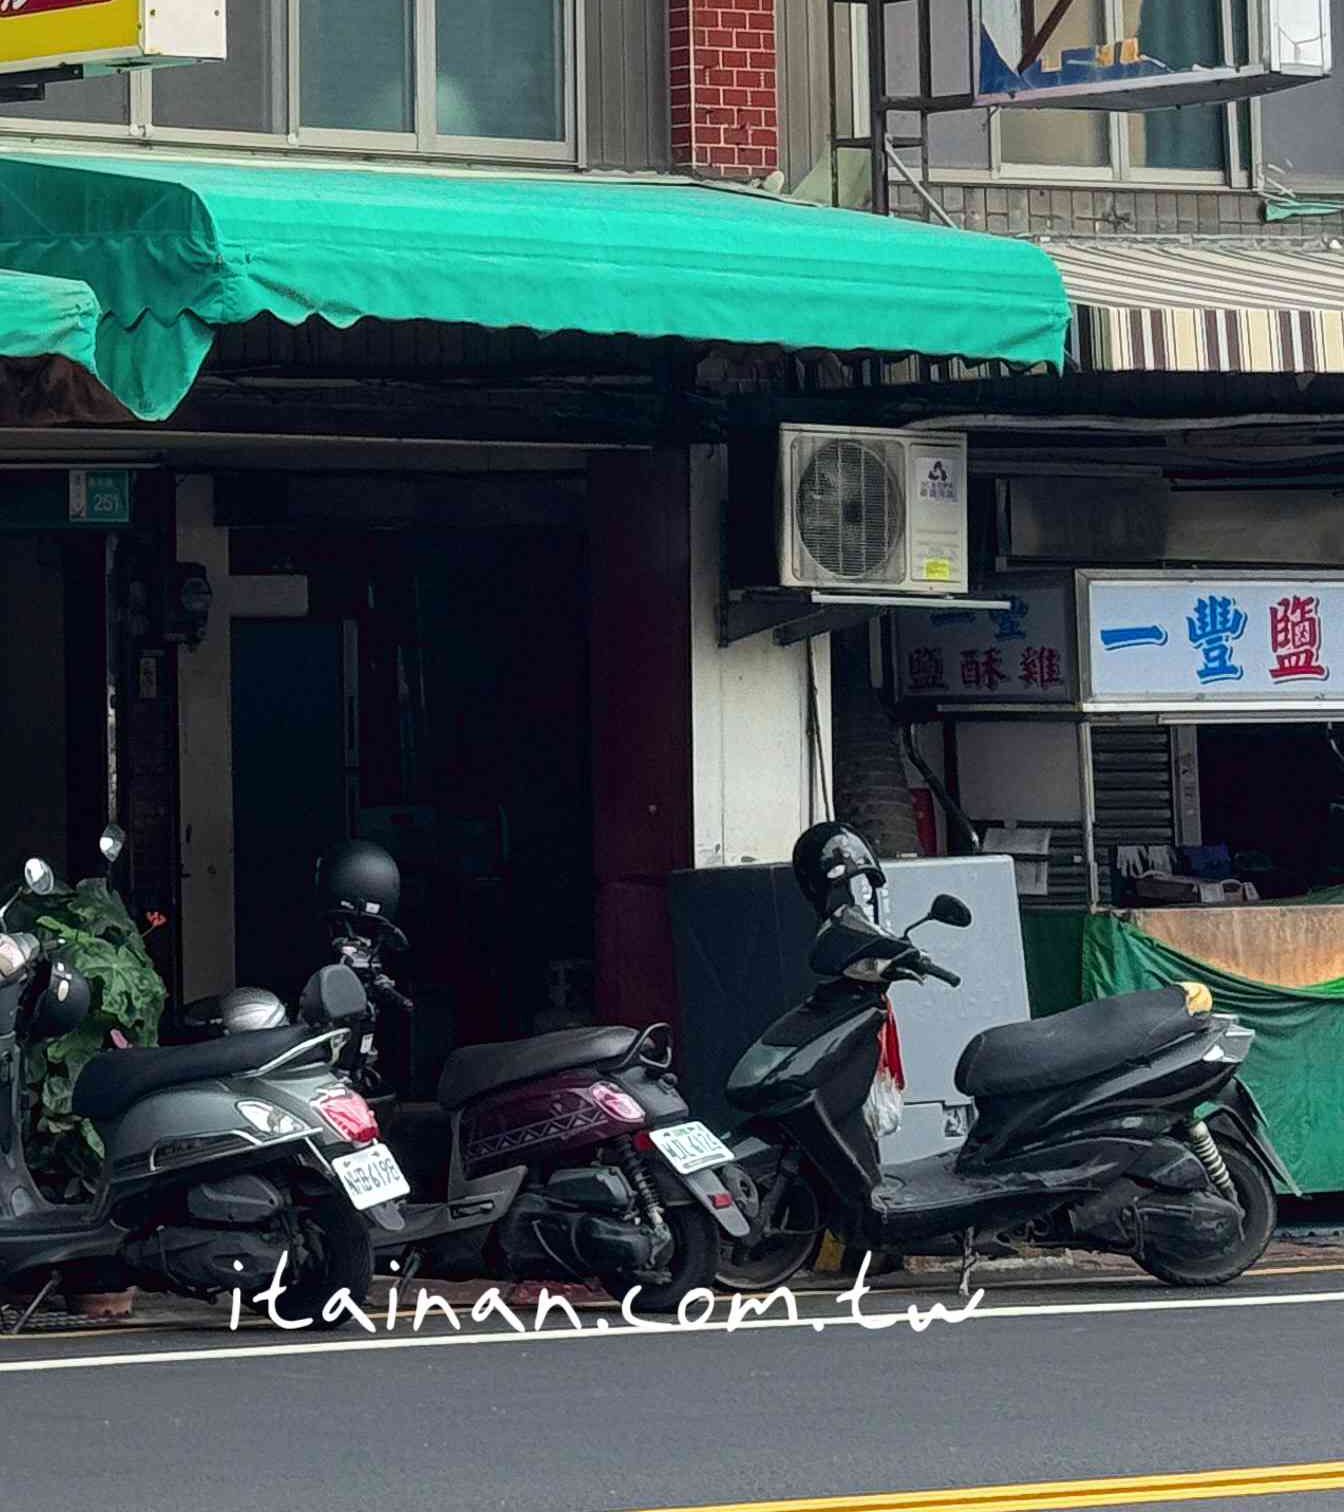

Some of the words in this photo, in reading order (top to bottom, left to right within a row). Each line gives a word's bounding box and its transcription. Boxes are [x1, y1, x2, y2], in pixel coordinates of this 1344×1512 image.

[909, 646, 1064, 691] 鹽酥雞
[1100, 594, 1330, 685] 一豐鹽
